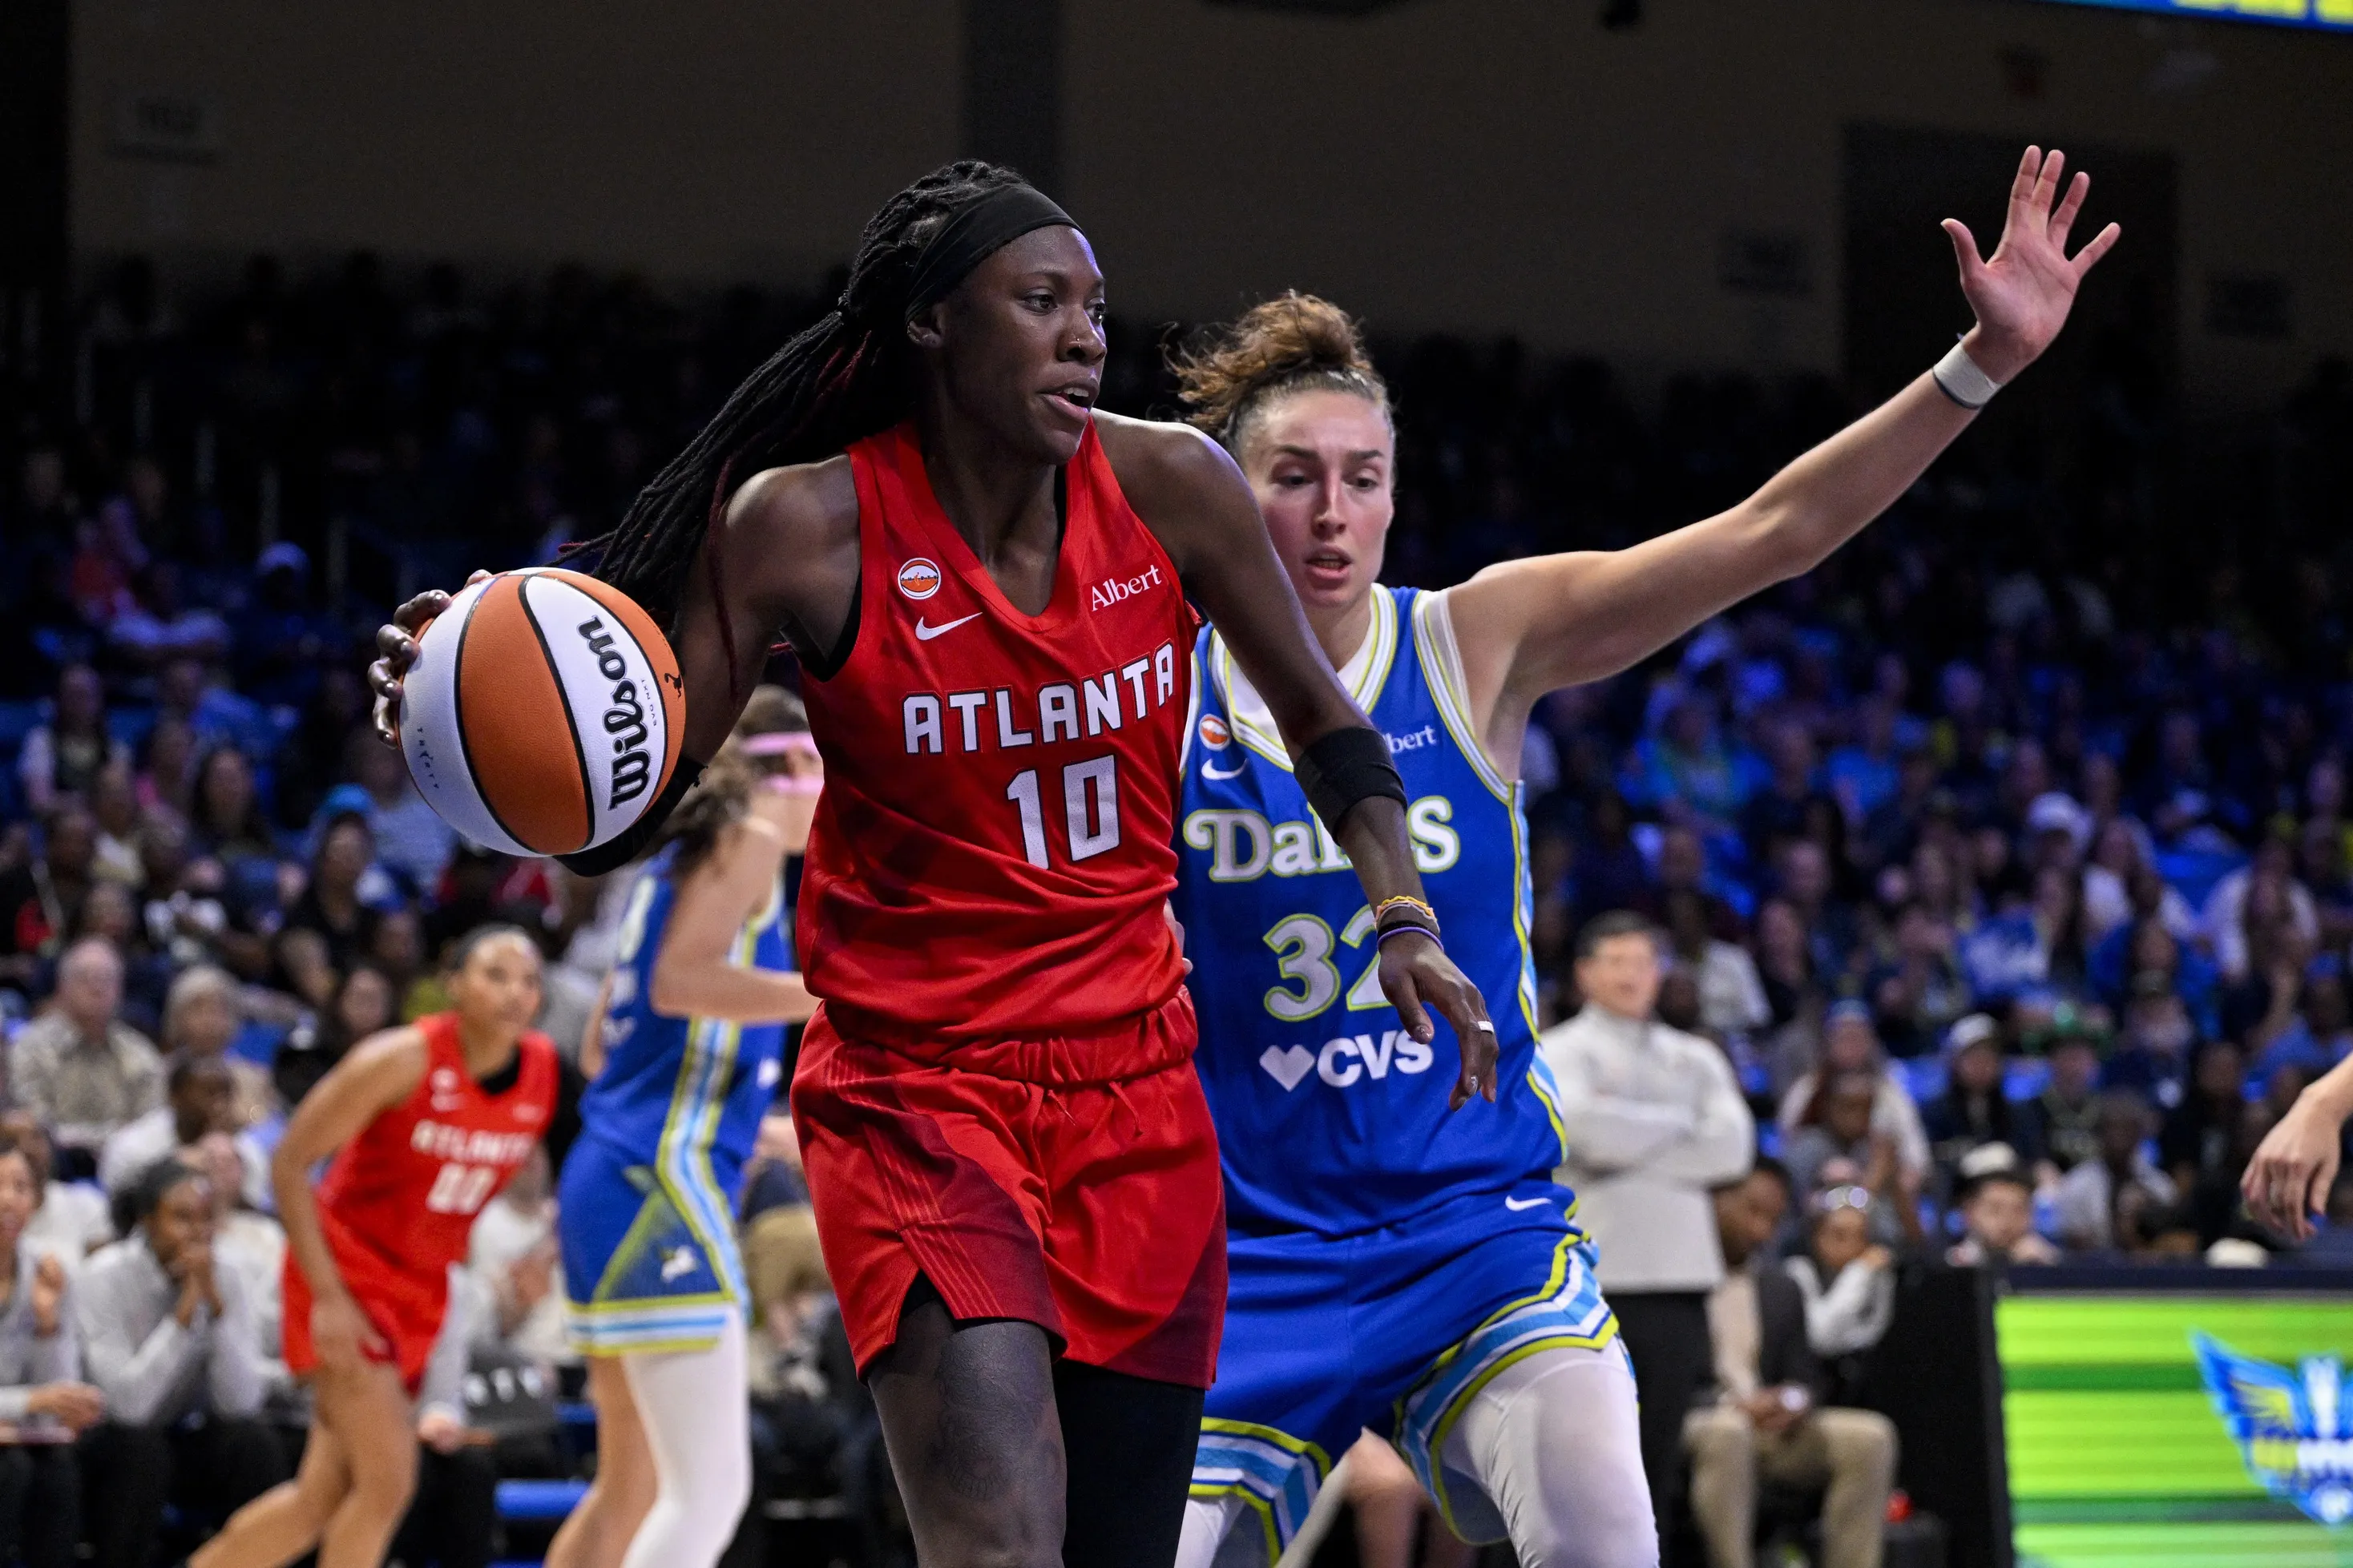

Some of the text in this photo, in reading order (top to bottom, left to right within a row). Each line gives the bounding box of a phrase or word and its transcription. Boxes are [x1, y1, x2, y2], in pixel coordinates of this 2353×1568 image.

[1091, 564, 1162, 612] Albert
[576, 615, 652, 811] Wilson
[902, 638, 1174, 754] ATLANTA
[1382, 724, 1438, 755] bert
[1006, 754, 1120, 871] 10
[1317, 1030, 1434, 1087] CVS
